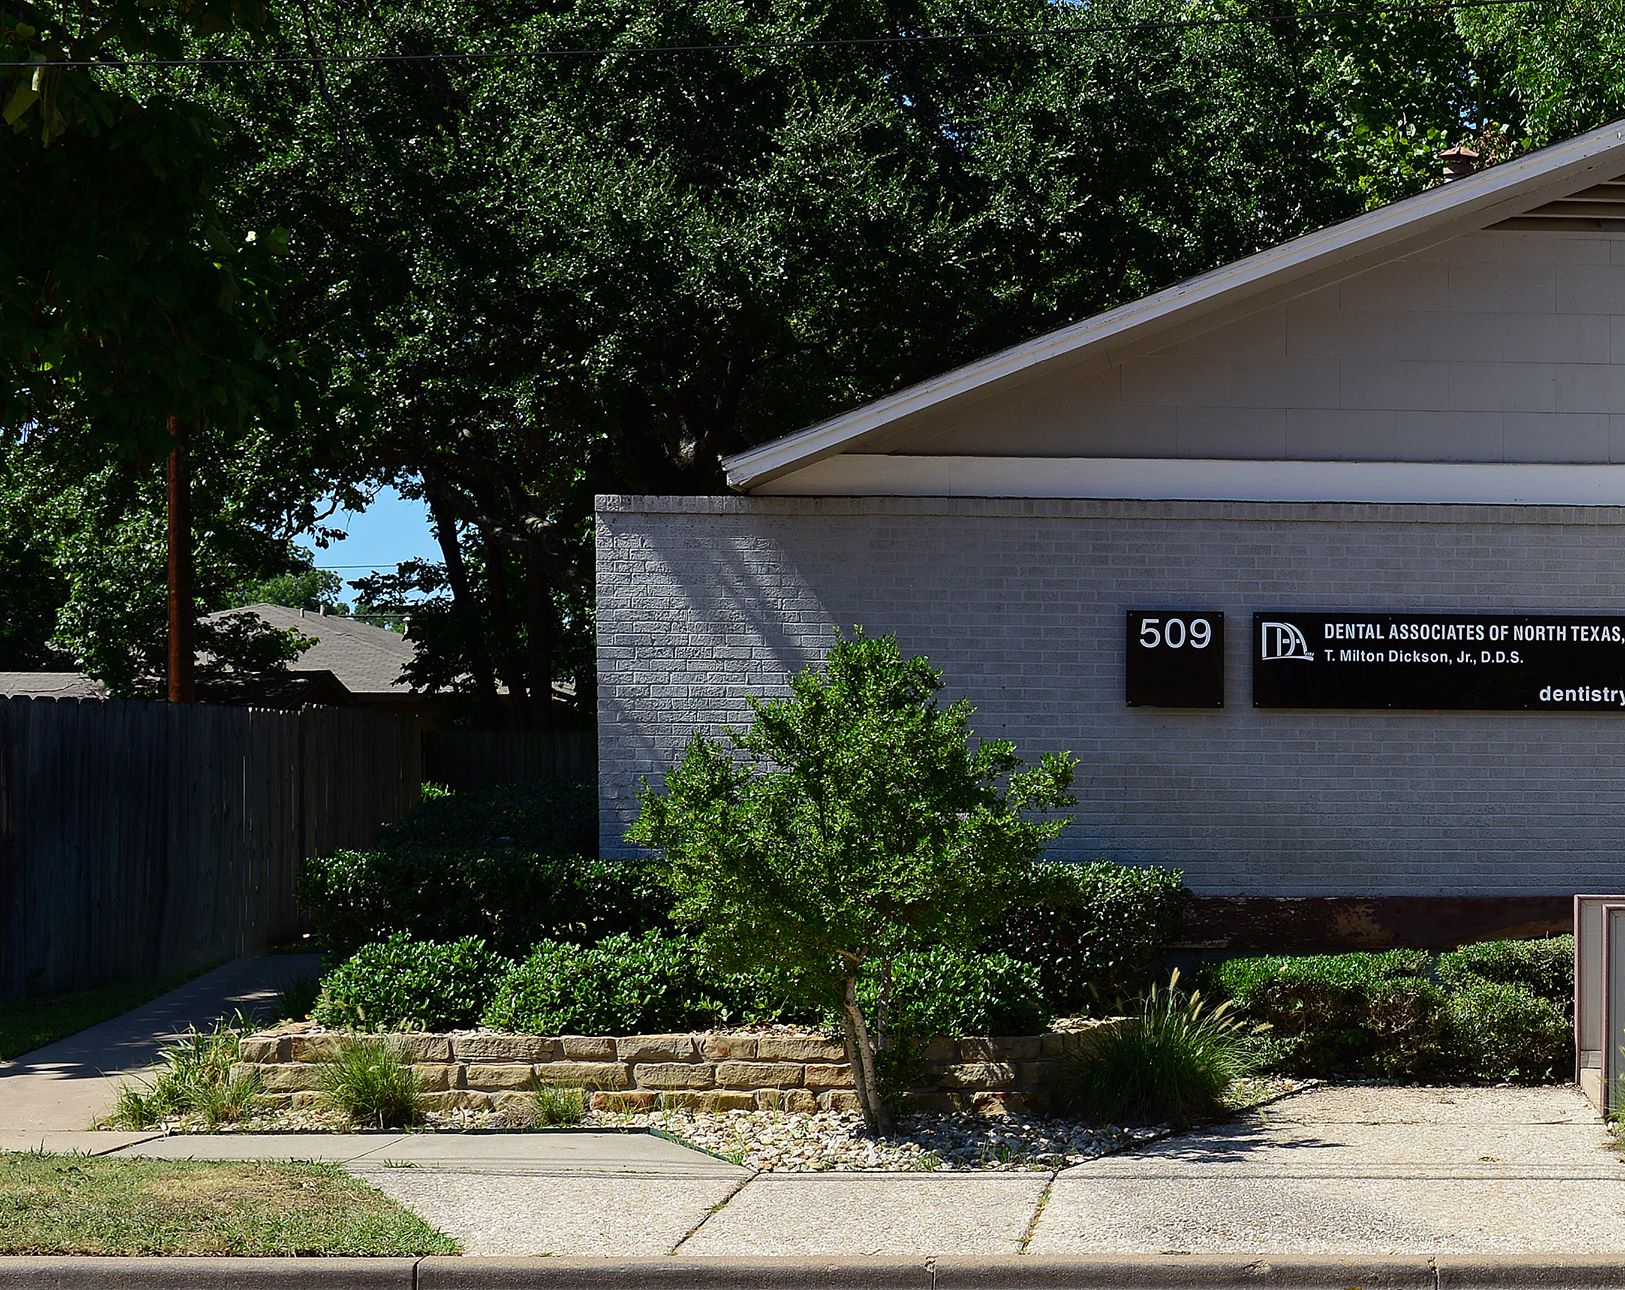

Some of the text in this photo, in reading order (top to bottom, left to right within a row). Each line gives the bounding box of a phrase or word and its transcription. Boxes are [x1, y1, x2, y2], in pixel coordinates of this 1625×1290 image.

[1139, 618, 1212, 649] 509
[1324, 623, 1385, 640] DENTAL
[1388, 623, 1485, 641] ASSOCIATES
[1489, 624, 1509, 641] OF
[1513, 625, 1567, 642] NORTH
[1570, 625, 1625, 645] TEXAS,
[1324, 649, 1524, 666] T. Milton Dickson, Jr., D.D.S.
